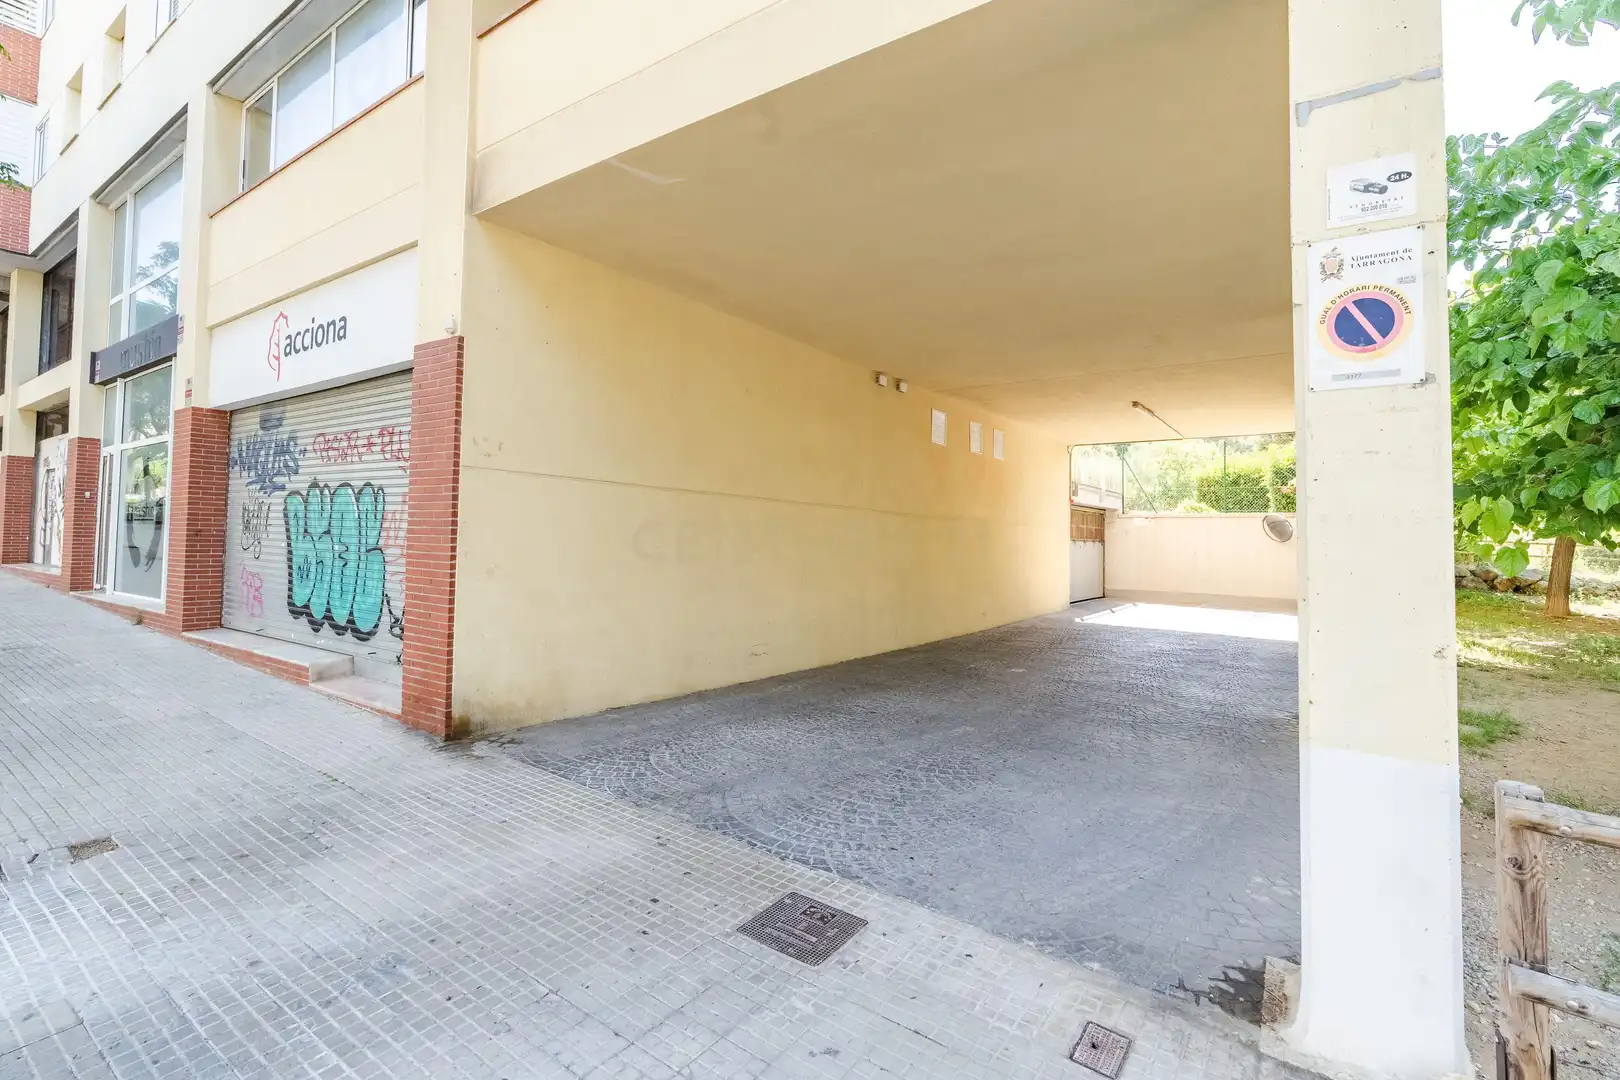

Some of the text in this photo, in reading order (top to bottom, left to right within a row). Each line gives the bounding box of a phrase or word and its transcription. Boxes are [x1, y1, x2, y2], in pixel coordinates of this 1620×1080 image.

[1389, 174, 1400, 182] 24
[1349, 255, 1413, 269] TARRAGONA
[1350, 249, 1400, 262] Ajuntament
[1319, 284, 1412, 325] GUAL D'HORARI PERMANENT
[283, 315, 348, 358] acciona
